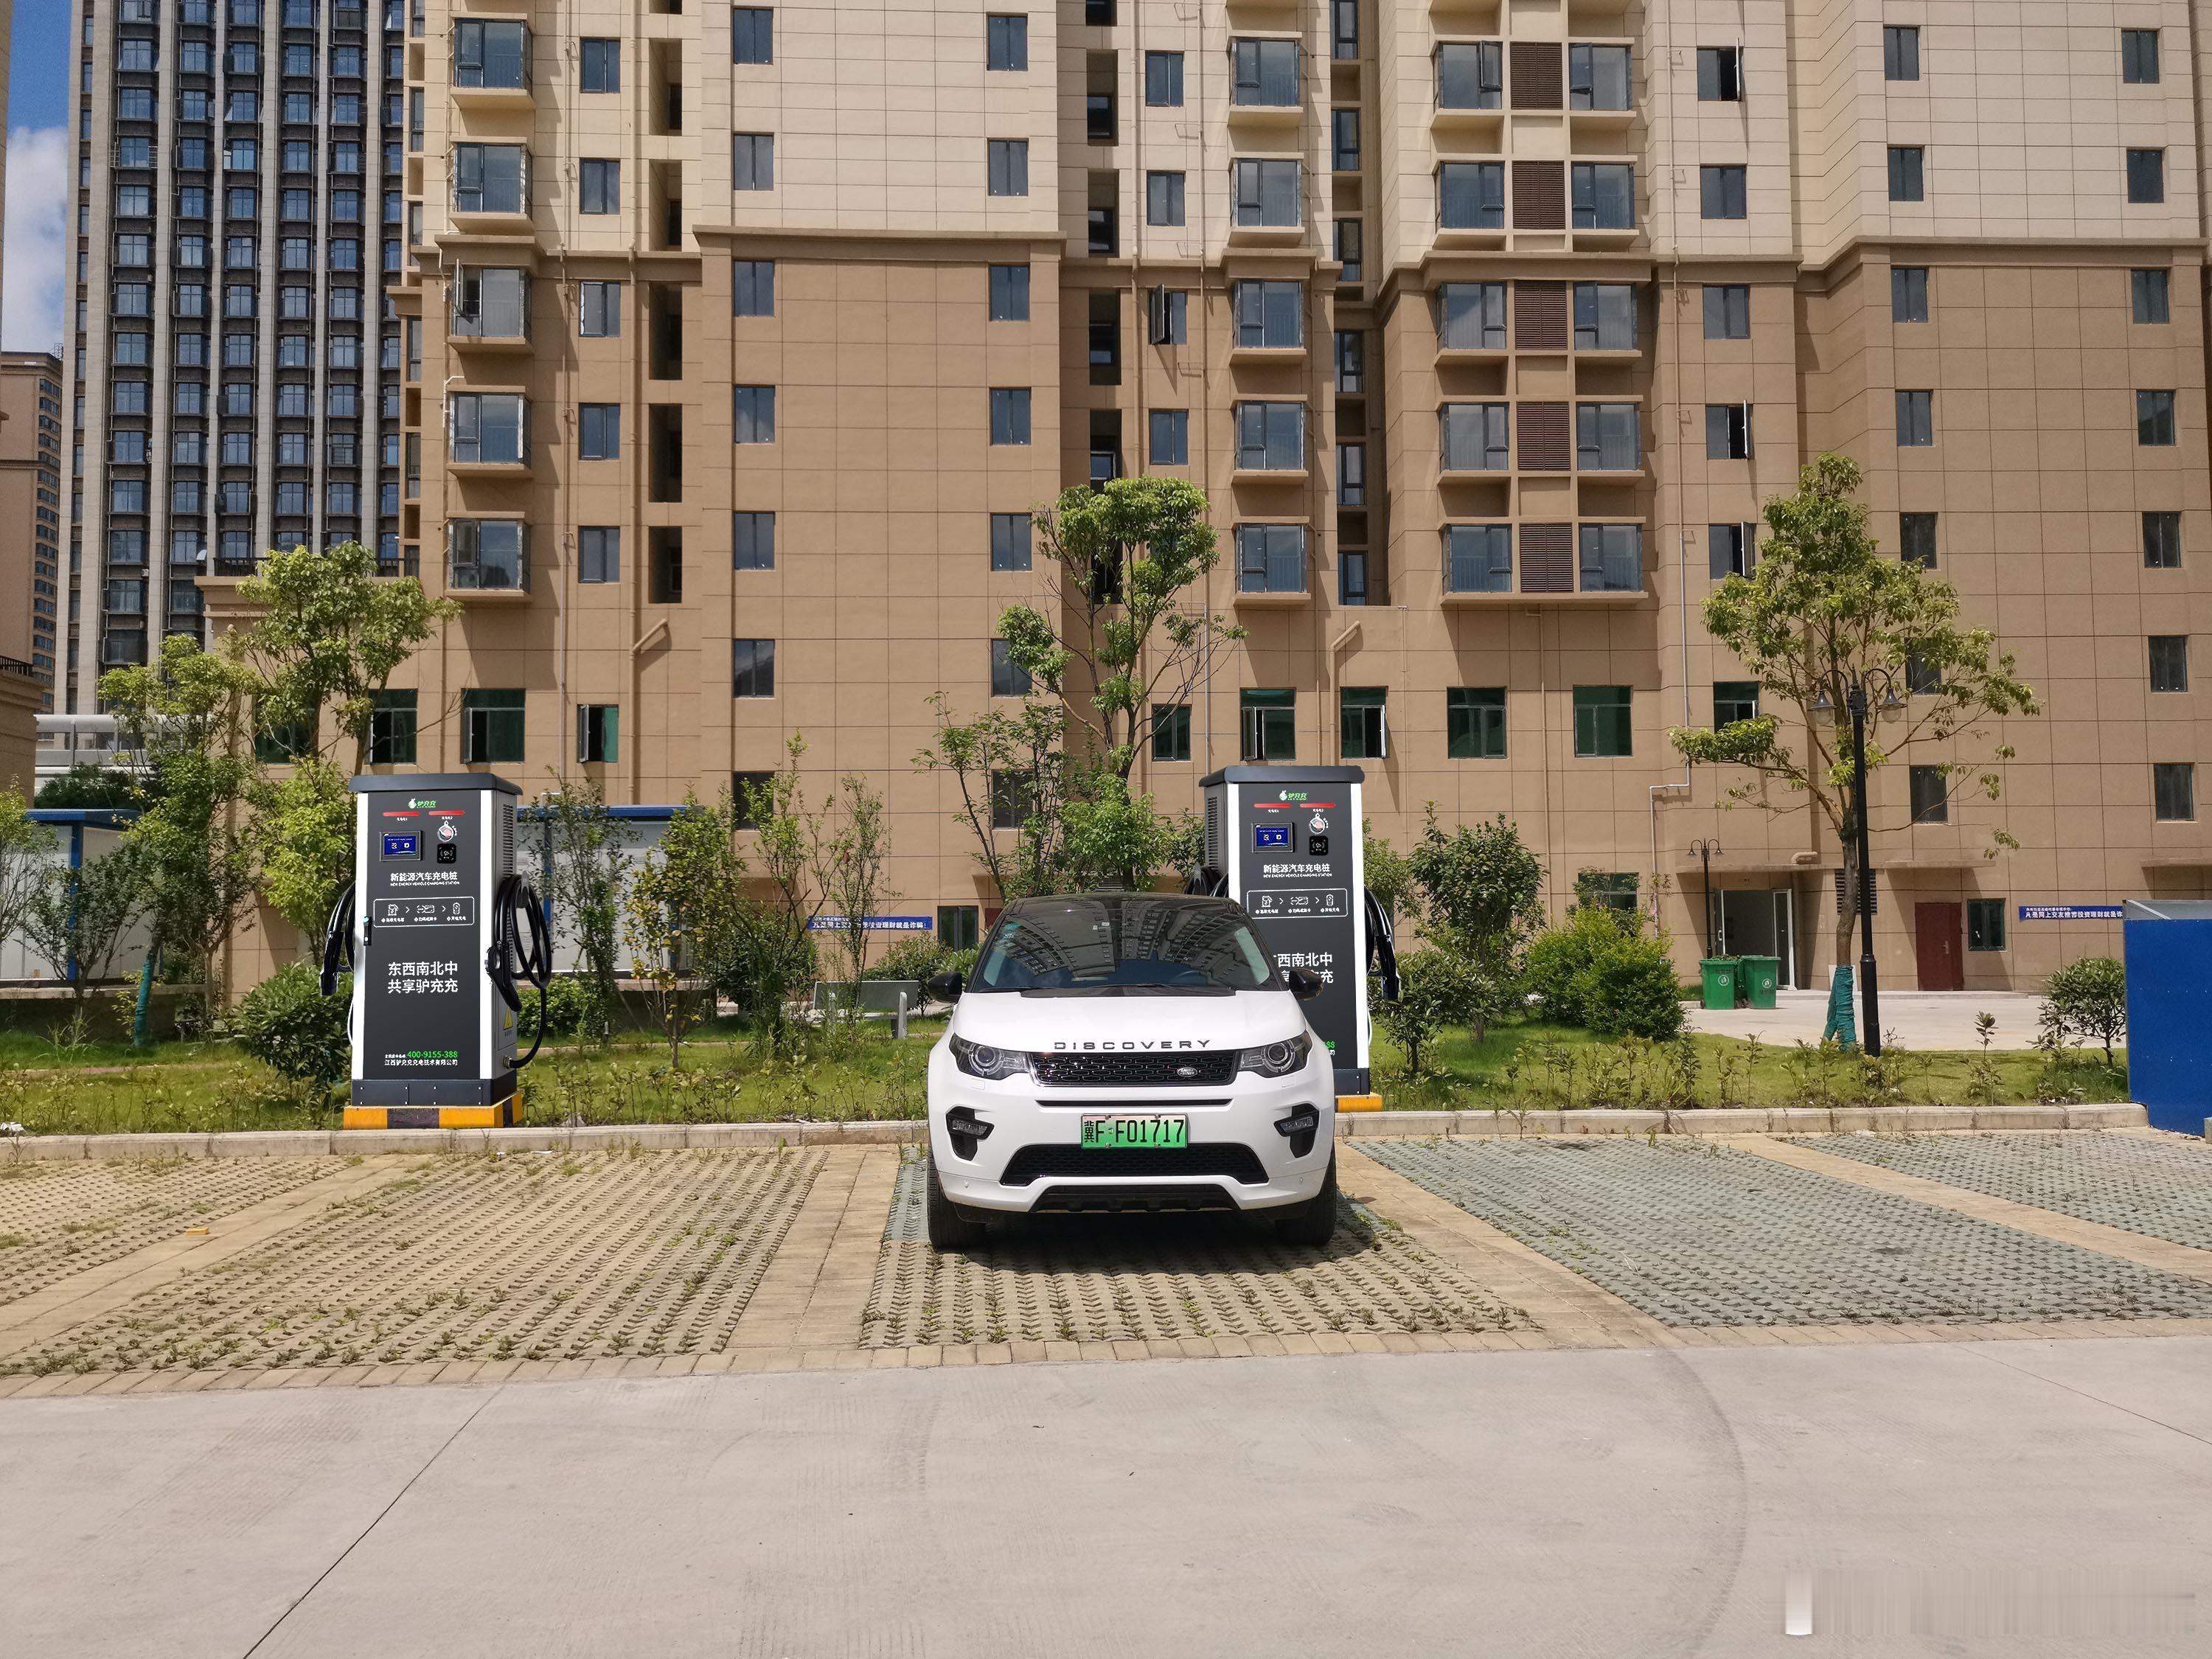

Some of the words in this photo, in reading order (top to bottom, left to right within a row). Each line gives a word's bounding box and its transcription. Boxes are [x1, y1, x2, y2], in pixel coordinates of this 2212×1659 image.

[1263, 863, 1330, 874] 新能源汽车充电桩
[390, 871, 458, 882] 新能源汽车充电桩
[1273, 951, 1332, 967] 西南北中
[388, 960, 458, 976] 东西南北中
[387, 978, 459, 994] 共享驴充充
[1054, 1040, 1210, 1050] DISCOVERY
